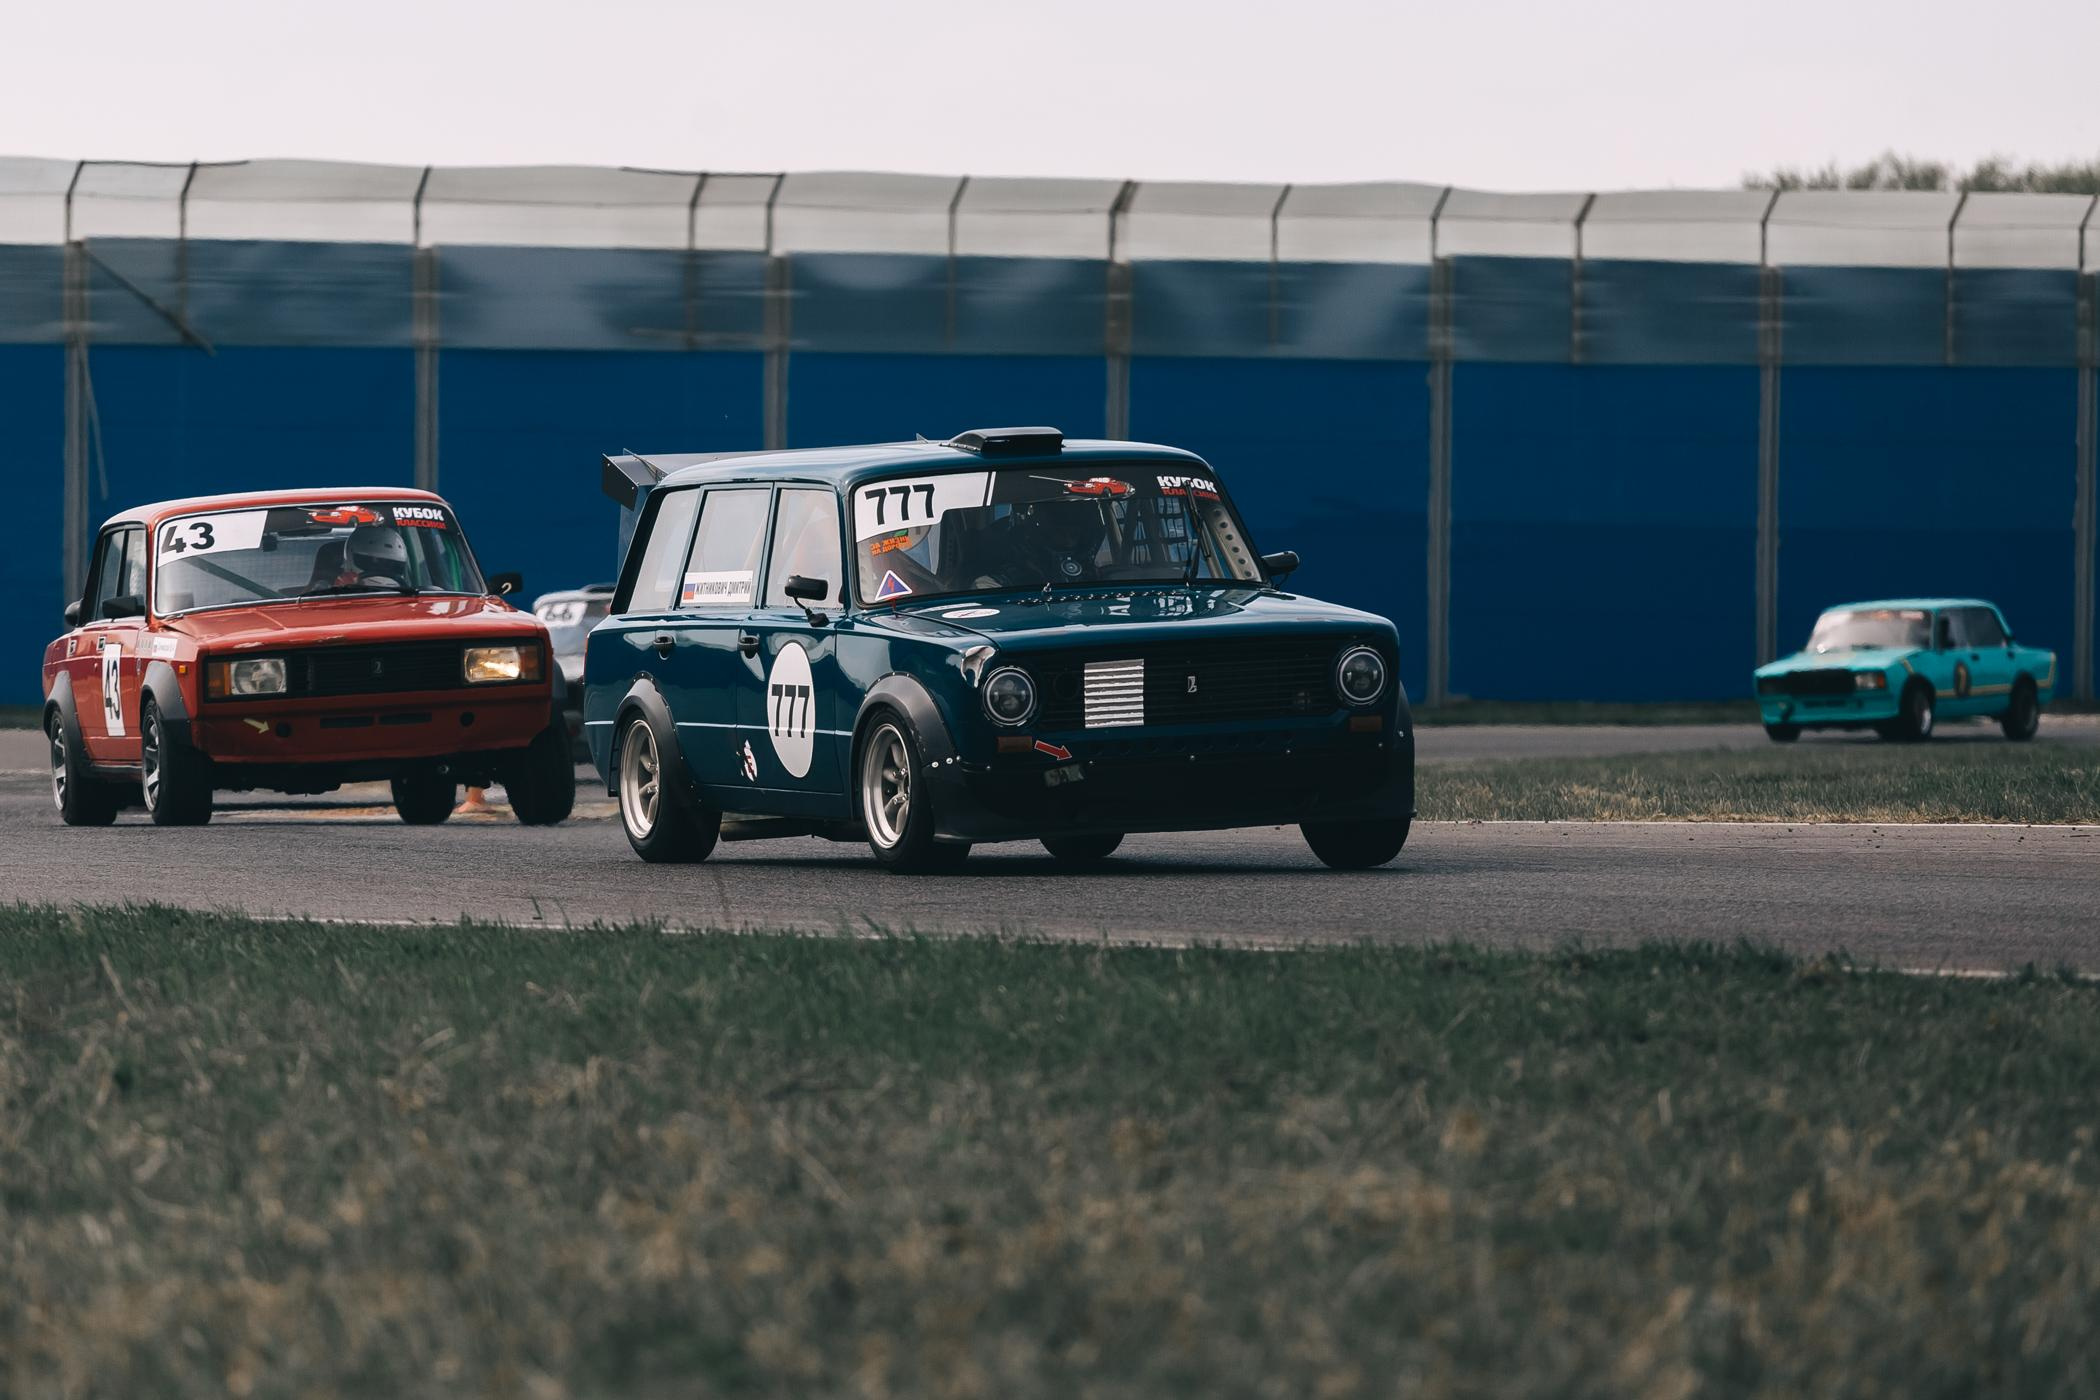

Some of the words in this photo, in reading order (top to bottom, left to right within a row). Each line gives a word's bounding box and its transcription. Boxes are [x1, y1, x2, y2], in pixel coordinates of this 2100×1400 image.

[1157, 475, 1217, 493] КУБОК
[1162, 487, 1221, 501] КЛАСИКИ
[392, 506, 444, 521] КУБОК
[865, 484, 935, 526] 777
[395, 519, 446, 529] КЛАССИКИ
[161, 522, 215, 553] 43
[104, 659, 120, 720] 43
[771, 683, 810, 738] 777
